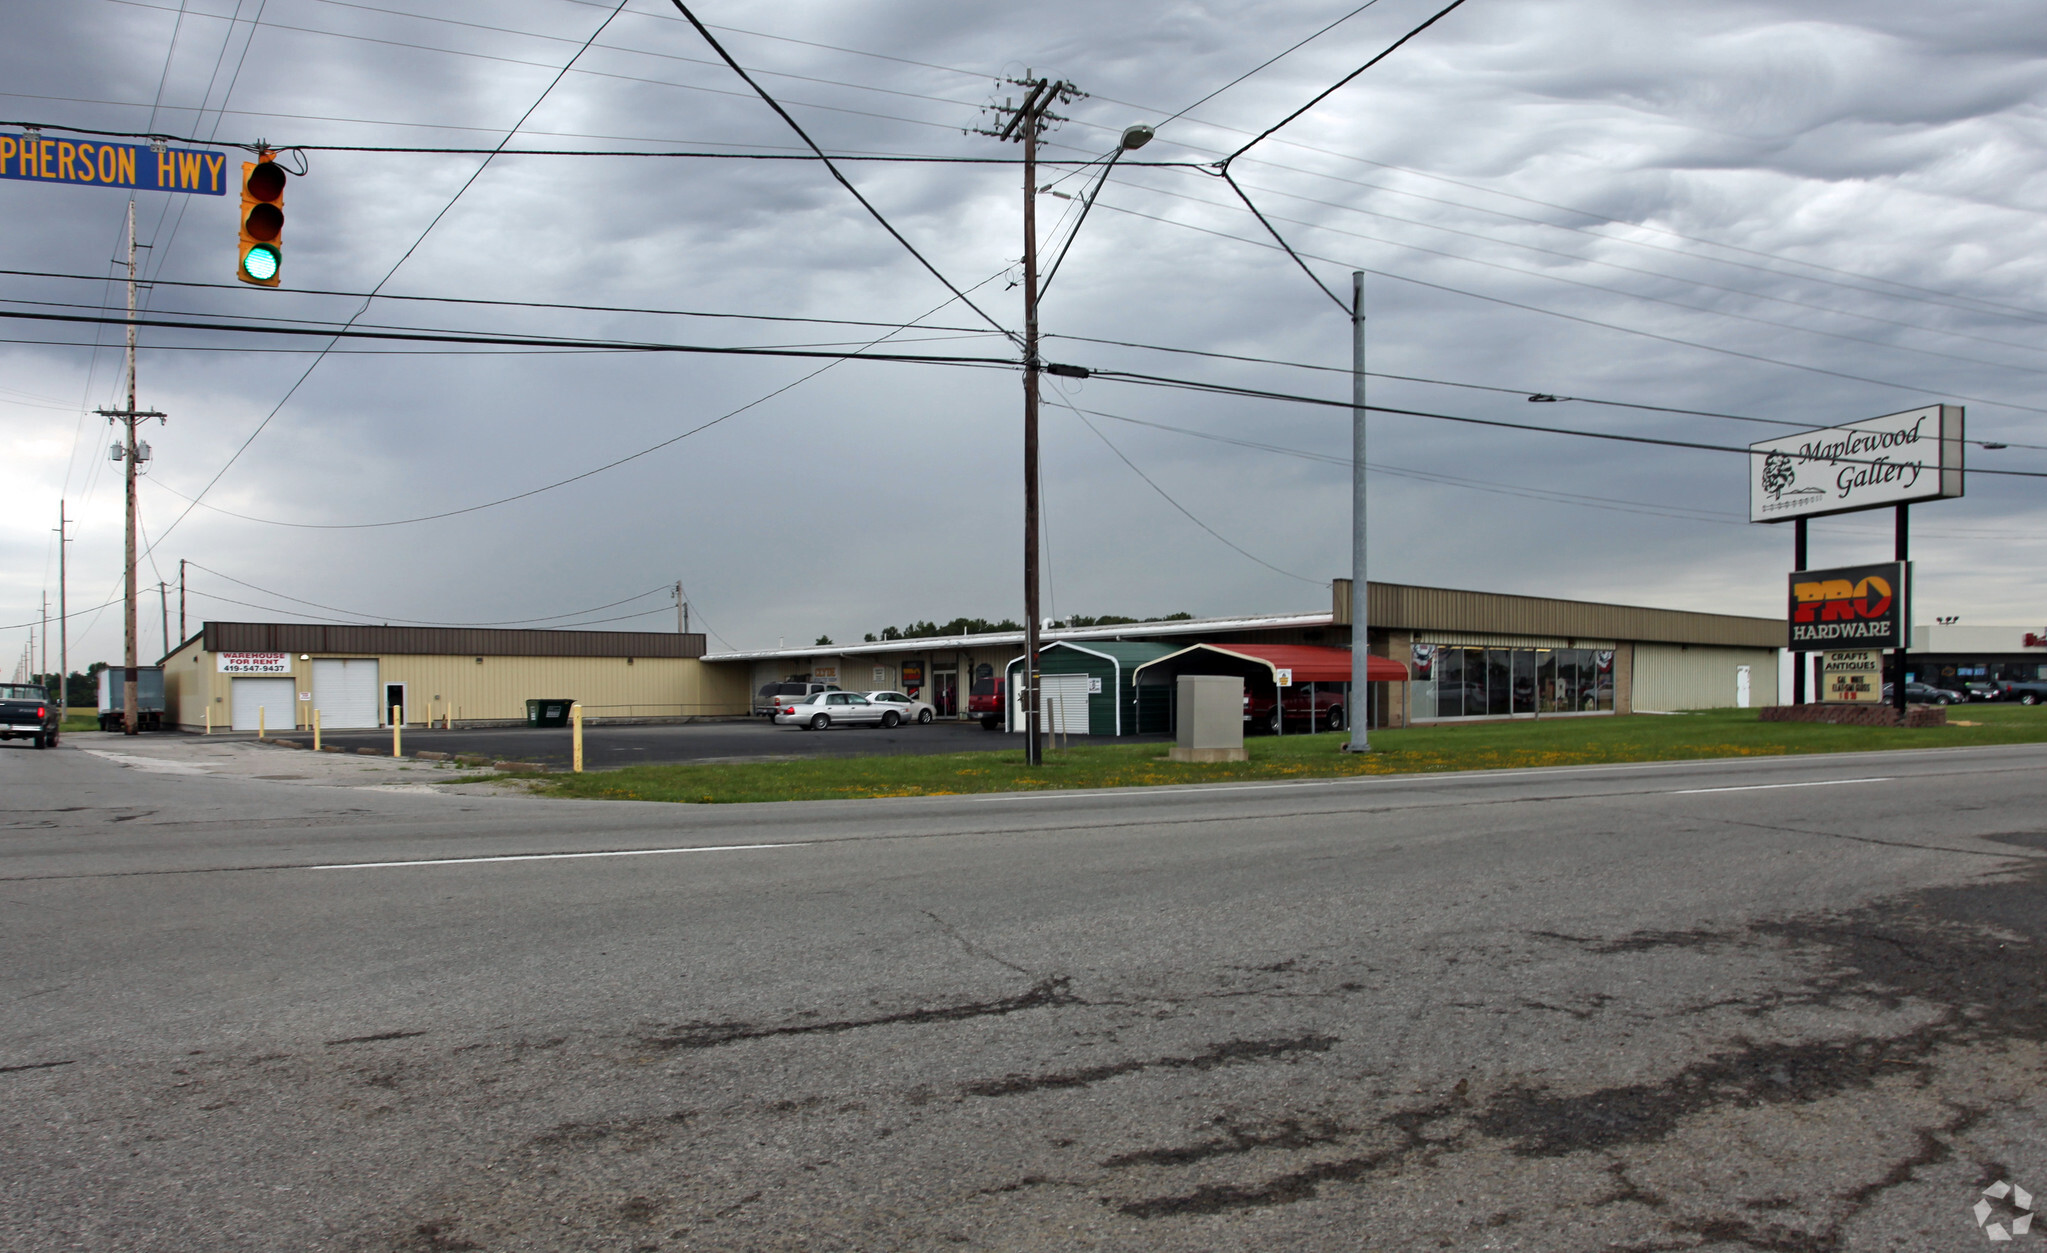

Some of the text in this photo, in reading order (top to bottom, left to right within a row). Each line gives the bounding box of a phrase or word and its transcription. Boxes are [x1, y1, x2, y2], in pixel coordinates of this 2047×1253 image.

[0, 136, 225, 191] PHERSON HWY
[1798, 416, 1927, 466] Maplewood
[1837, 456, 1922, 498] Gallery
[1794, 575, 1892, 623] PRO
[1793, 621, 1891, 640] HARDWARE
[1825, 661, 1875, 670] ANTIQUES
[1831, 652, 1868, 660] CRAFTS
